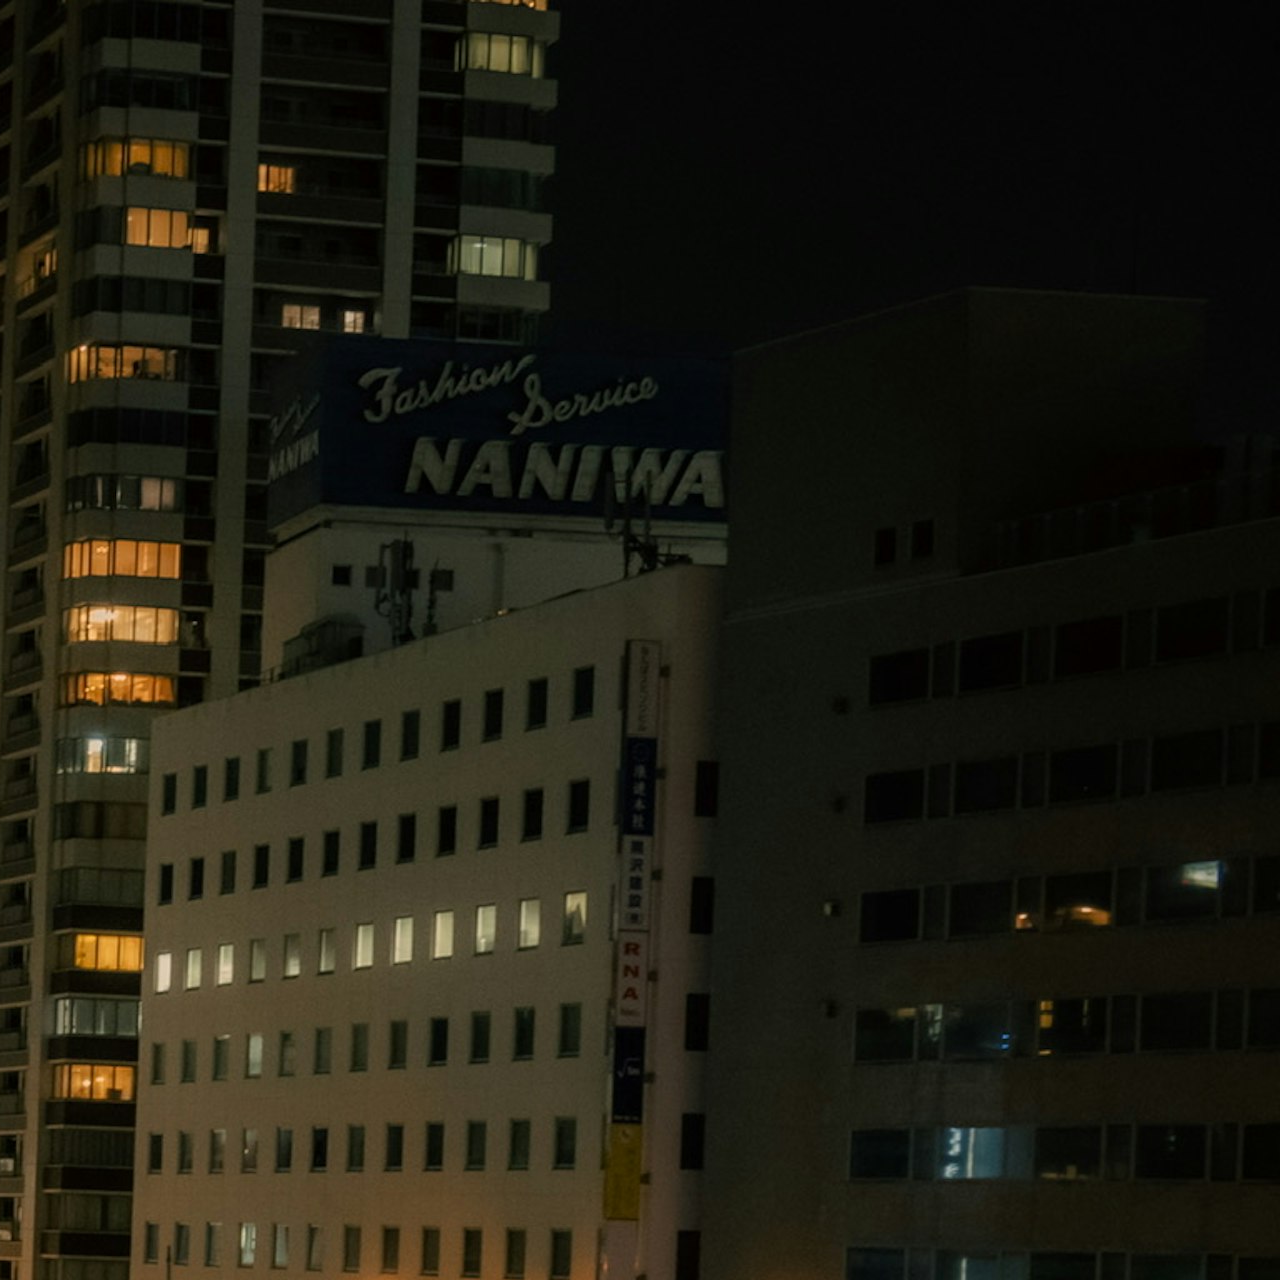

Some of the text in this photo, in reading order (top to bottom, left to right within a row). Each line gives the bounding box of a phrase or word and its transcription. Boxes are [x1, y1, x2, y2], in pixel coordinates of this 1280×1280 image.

[357, 353, 538, 424] Fashion
[507, 372, 659, 436] Service
[403, 435, 725, 509] NANIWA
[622, 942, 640, 1000] RNA
